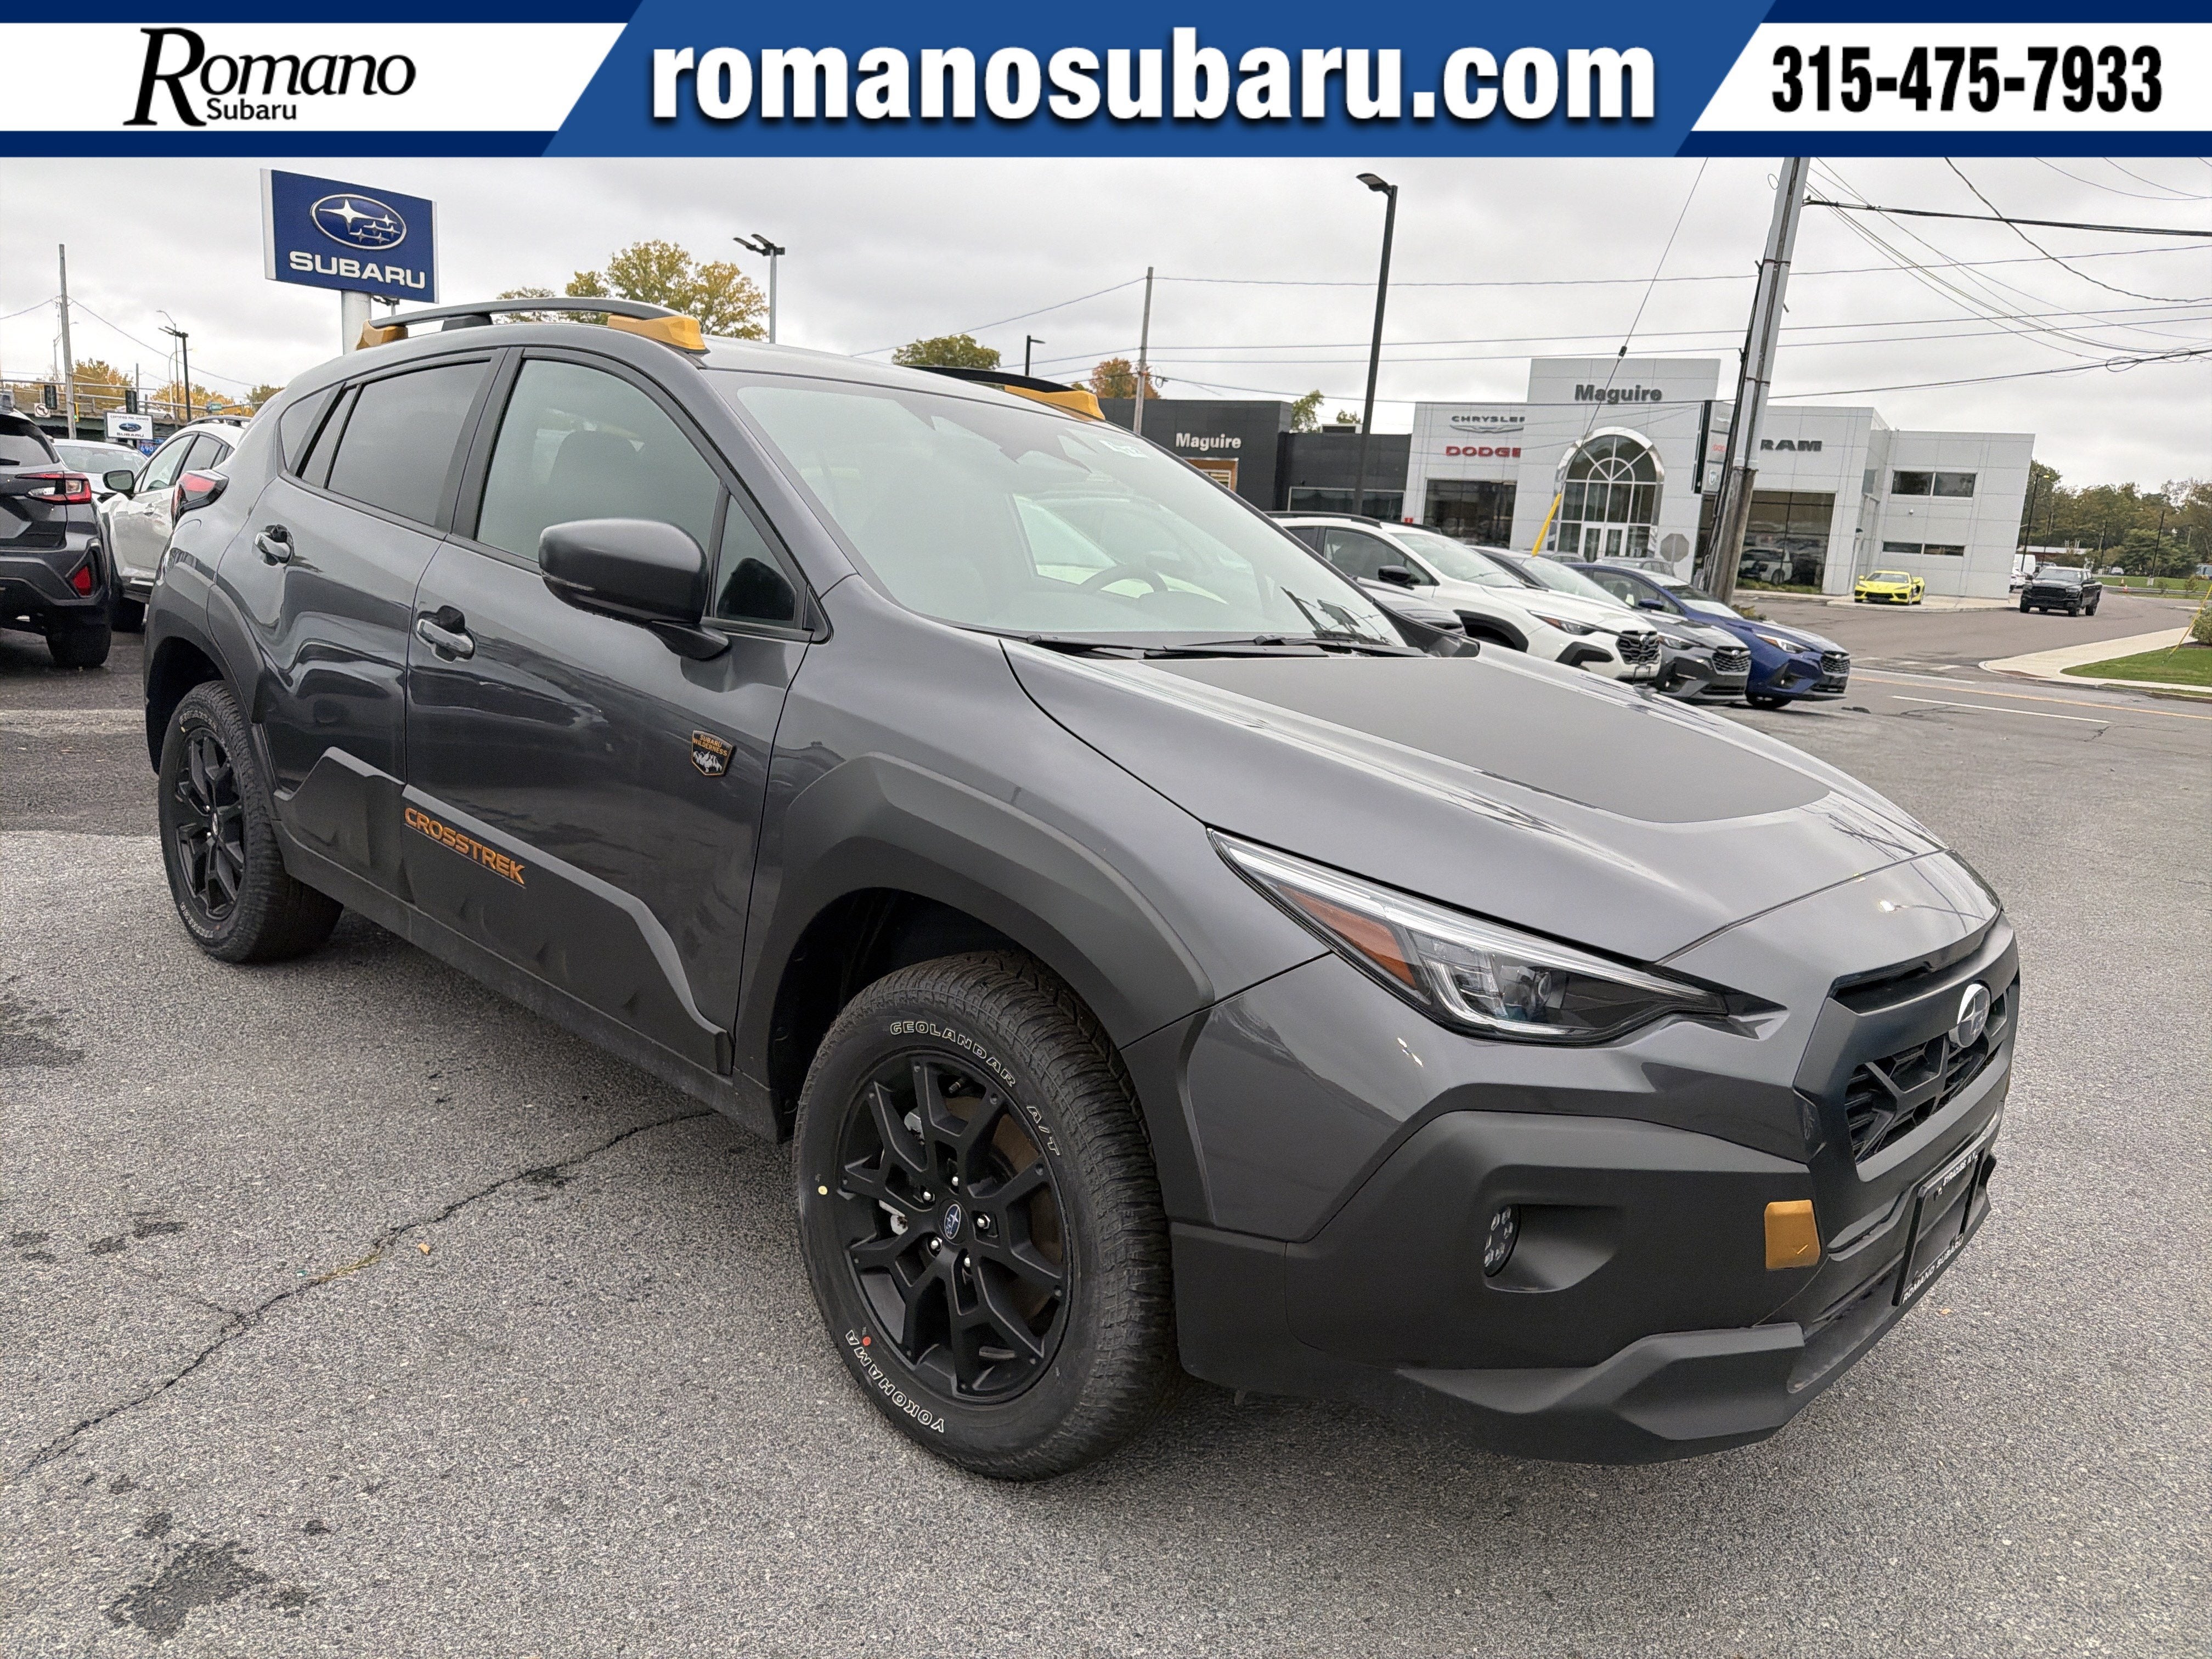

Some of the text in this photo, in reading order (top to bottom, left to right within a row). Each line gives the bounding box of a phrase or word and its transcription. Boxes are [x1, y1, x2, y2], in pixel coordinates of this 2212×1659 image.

[289, 250, 426, 289] SUBARU
[1575, 384, 1662, 405] Maguire
[1175, 432, 1242, 452] Maguire
[1760, 439, 1822, 452] RAM
[693, 737, 728, 757] WILDERNESS
[699, 734, 723, 748] SUBARU
[404, 807, 525, 885] CROSSTREK
[889, 1021, 1060, 1156] GEOLANDAR A/T
[1901, 1236, 1964, 1305] ROMANO SUBARU
[845, 1329, 945, 1433] YOKOHAMA
